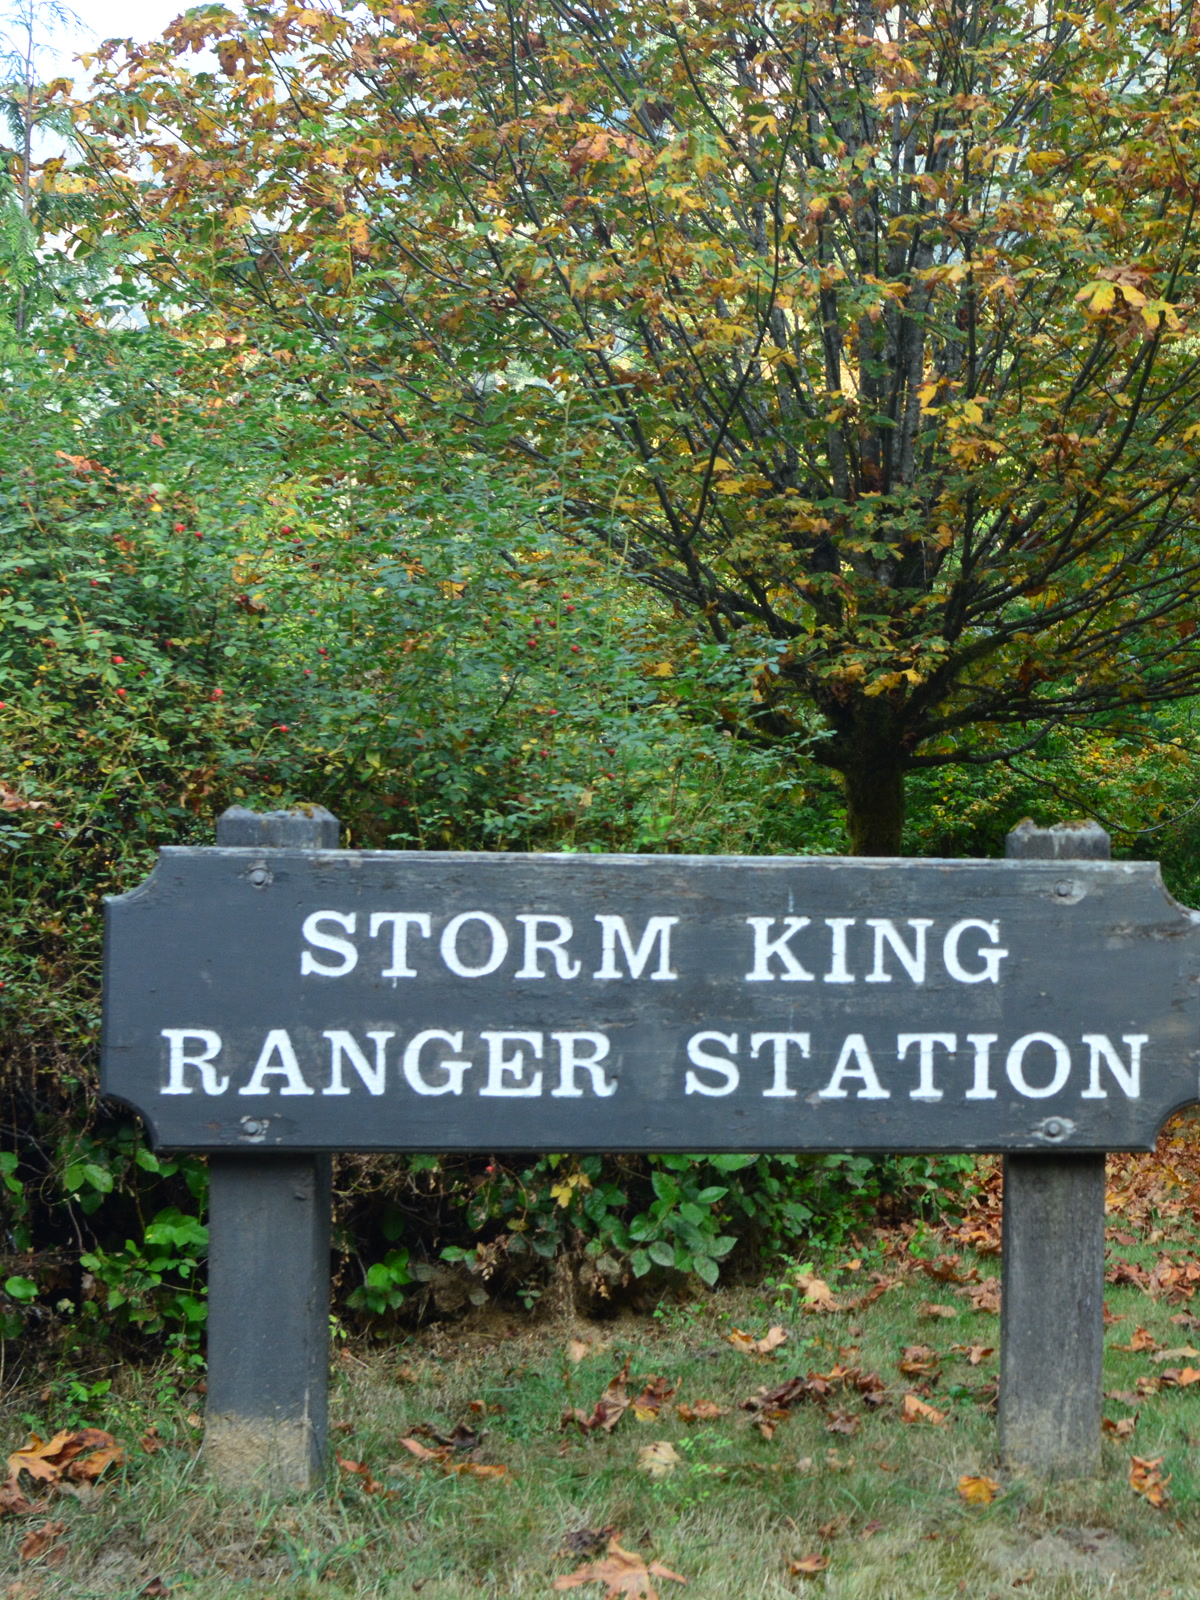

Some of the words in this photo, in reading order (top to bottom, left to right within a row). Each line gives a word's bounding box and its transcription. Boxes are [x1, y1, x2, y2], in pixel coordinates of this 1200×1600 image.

[300, 909, 680, 981] STORM
[743, 915, 1010, 985] KING
[159, 1027, 618, 1099] RANGER
[684, 1030, 1150, 1101] STATION
